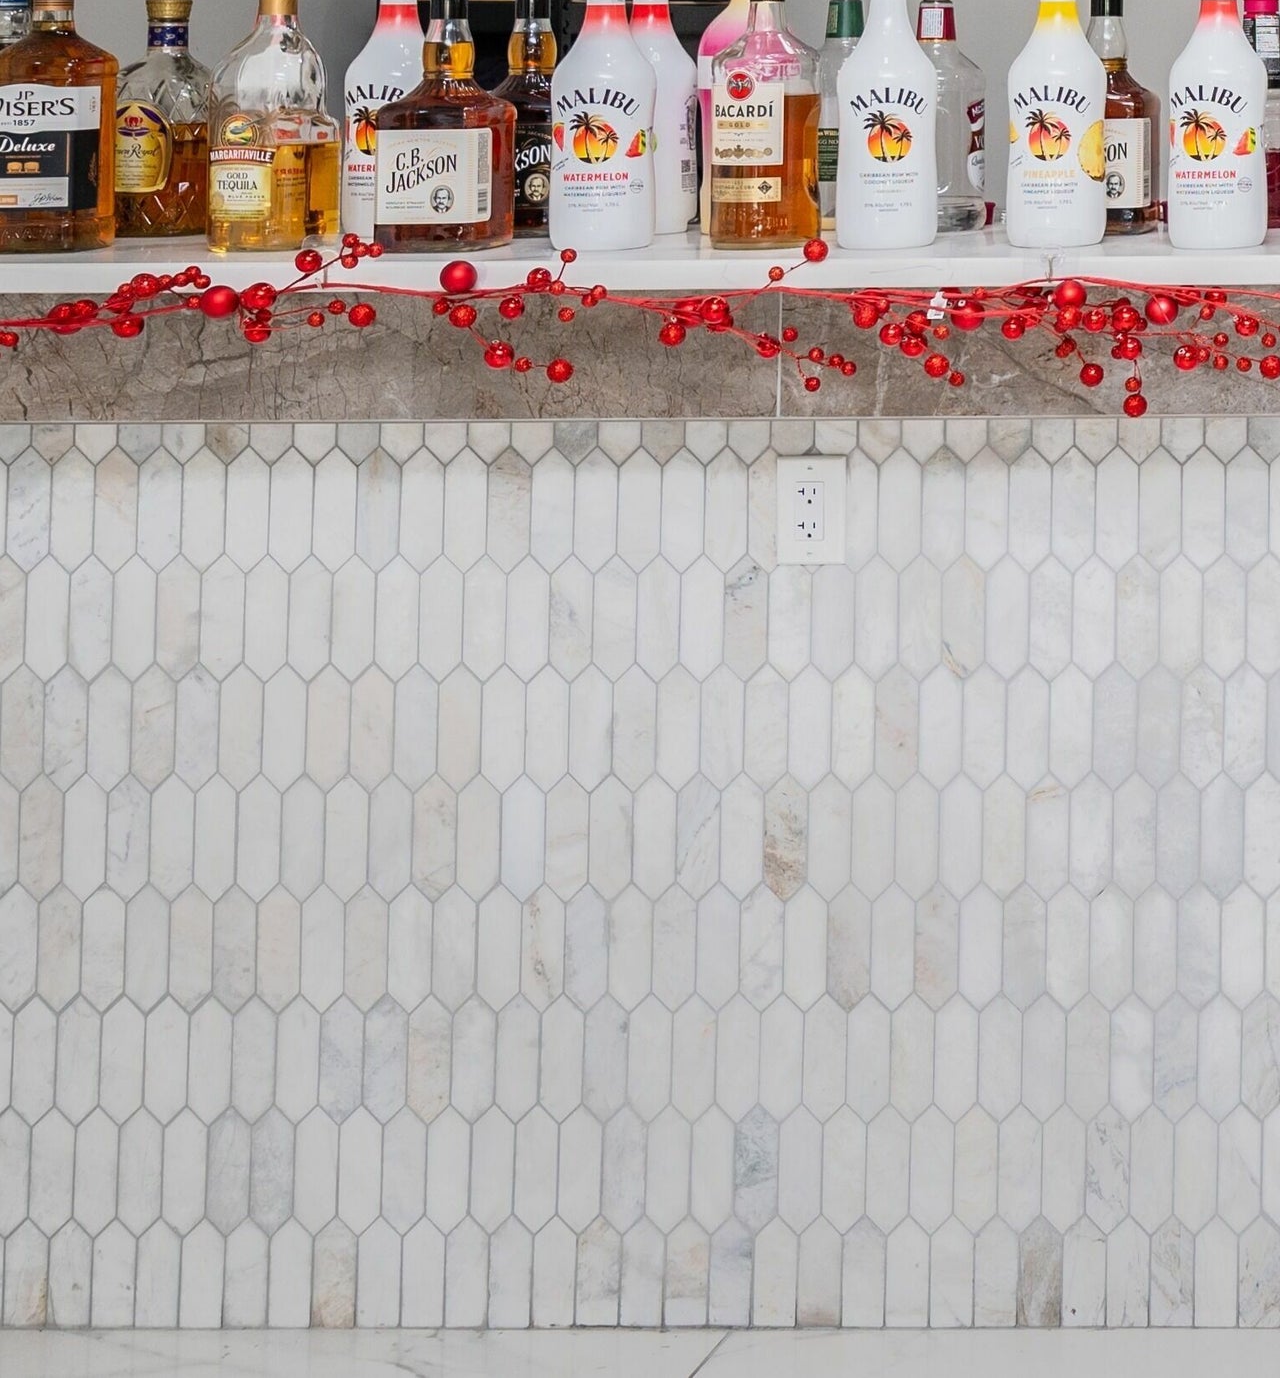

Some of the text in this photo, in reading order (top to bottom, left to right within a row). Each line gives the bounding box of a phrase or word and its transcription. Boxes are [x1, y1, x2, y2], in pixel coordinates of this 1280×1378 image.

[15, 90, 35, 101] JP
[345, 84, 404, 107] MALIB
[556, 87, 641, 118] MALIBU
[849, 86, 928, 117] MALIBU
[1013, 84, 1091, 115] MALIBU
[1170, 84, 1248, 114] MALIBU
[715, 99, 775, 118] BACARDÍ
[13, 119, 36, 127] 1857
[0, 135, 56, 153] Deluxe
[348, 163, 375, 173] WATER
[396, 147, 424, 171] C.B.
[385, 154, 458, 194] JACKSON
[563, 172, 629, 182] WATERMELON
[1023, 169, 1076, 178] PINEAPPLE
[1175, 170, 1237, 180] WATERMELON
[216, 180, 258, 191] TEQUILA
